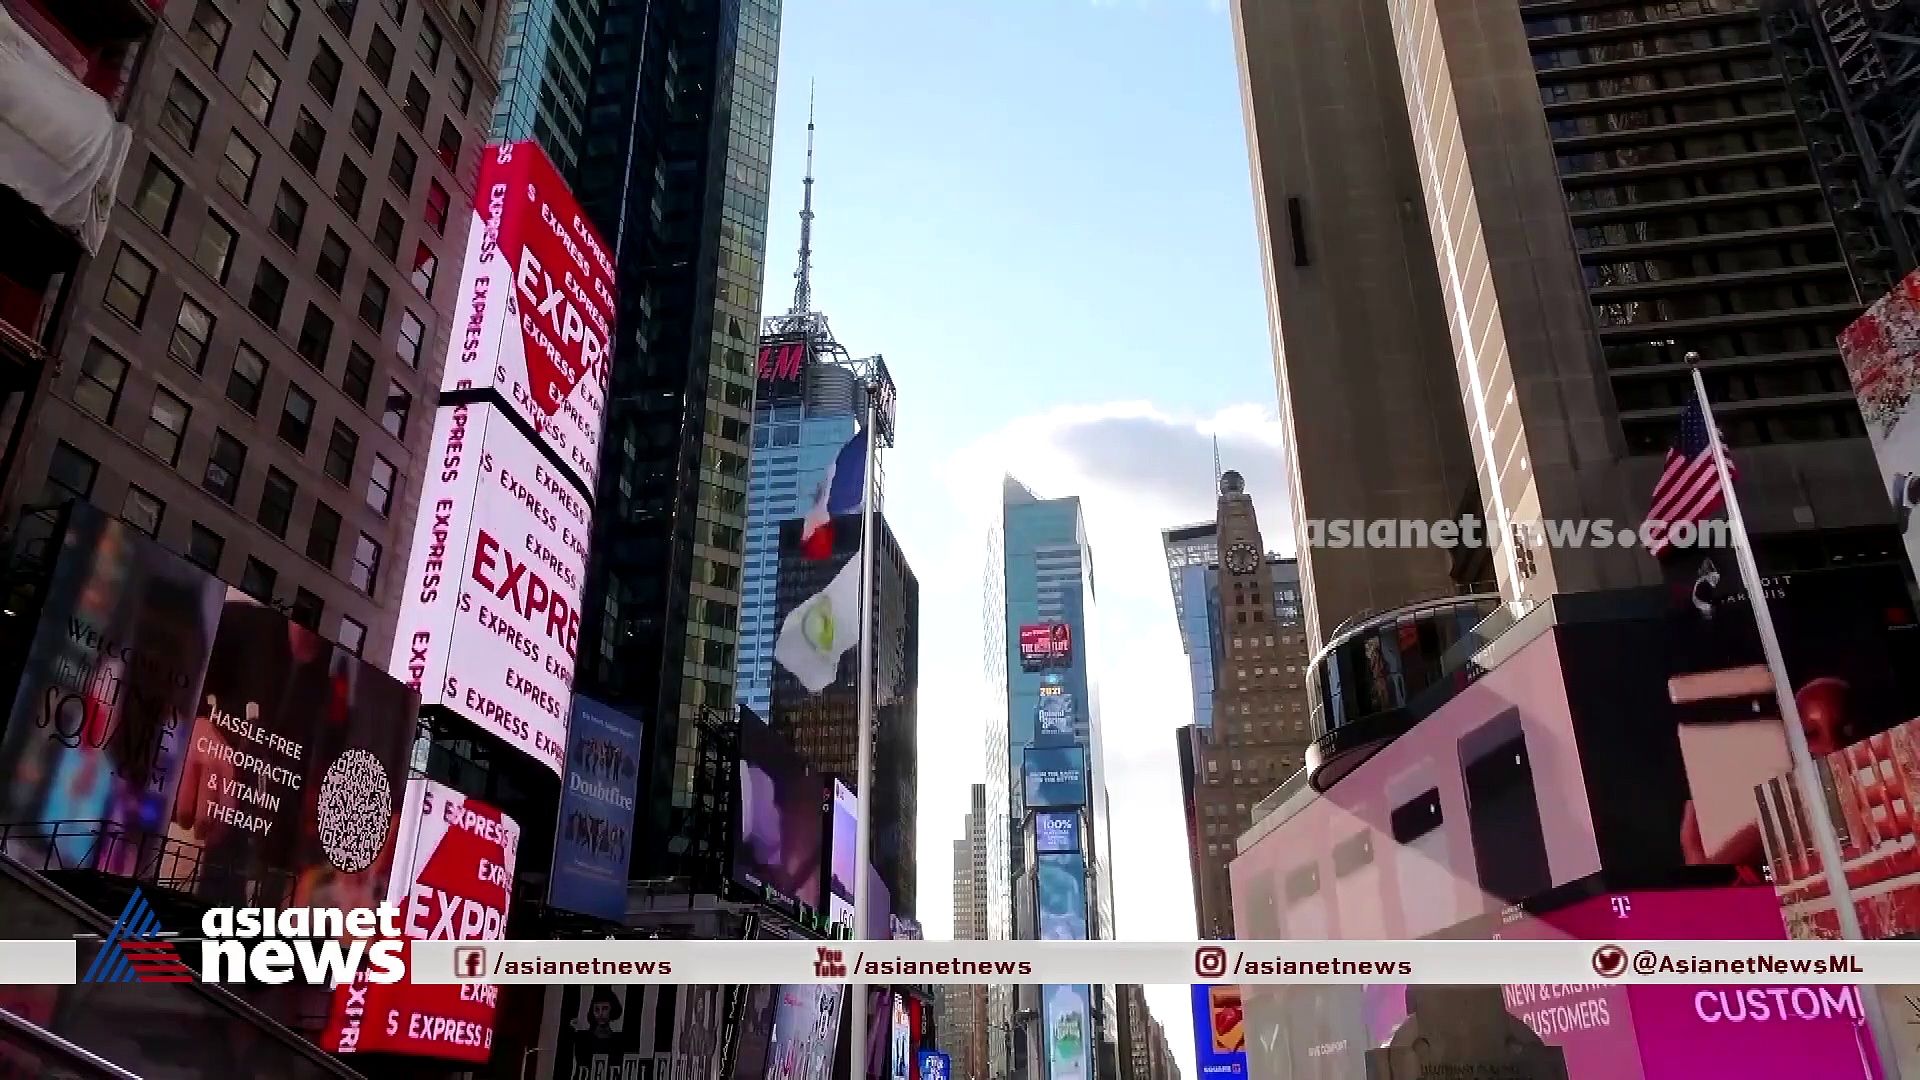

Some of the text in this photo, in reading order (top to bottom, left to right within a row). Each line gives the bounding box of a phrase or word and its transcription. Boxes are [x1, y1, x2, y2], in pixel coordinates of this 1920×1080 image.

[479, 183, 507, 263] EXPRESS
[541, 201, 591, 276] EXPRESS
[573, 213, 616, 285] EXPRESS
[461, 276, 490, 363] EXPRESS
[565, 270, 610, 342] EXPRESS
[507, 296, 517, 316] S
[523, 312, 576, 385] EXPRESS
[496, 365, 507, 384] S
[511, 381, 567, 449] EXPRESS
[548, 381, 597, 445] EXPRESS
[499, 468, 558, 533] EXPRESS
[535, 464, 586, 525] EXPRESS
[420, 499, 453, 603] EXPRESS
[525, 533, 577, 591] EXPRESS
[478, 605, 540, 663] EXPRESS
[446, 677, 458, 699] S
[465, 686, 530, 742] EXPRESS
[504, 667, 561, 719] EXPRESS
[209, 706, 303, 760] HASSLE-FREE
[196, 736, 301, 790] CHIROPRACTIC
[570, 771, 633, 811] Doubtfire
[206, 799, 273, 837] THERAPY
[207, 773, 281, 813] & VITAMIN
[443, 799, 509, 849] EXPRESS
[1043, 819, 1072, 829] 100%
[1504, 984, 1535, 1009] NEW
[1522, 997, 1610, 1036] CUSTOMERS
[386, 1009, 400, 1037] S
[408, 1011, 482, 1047] EXPRESS
